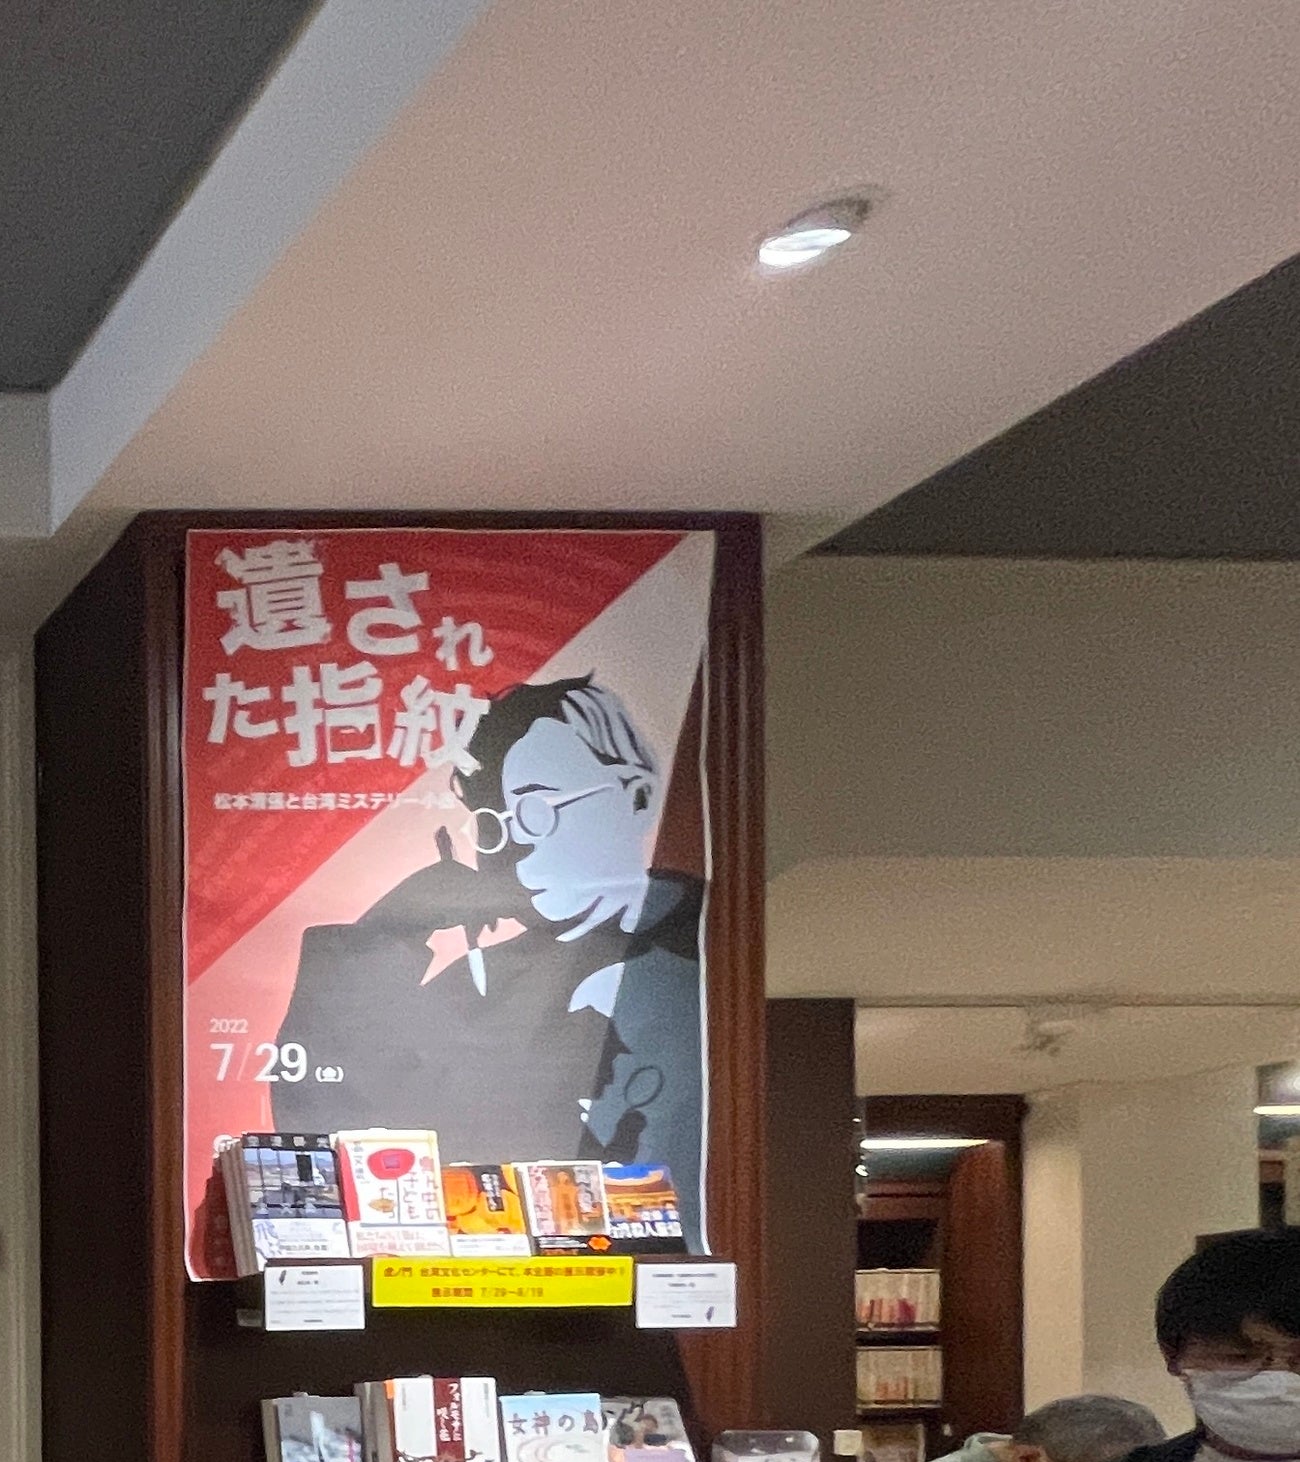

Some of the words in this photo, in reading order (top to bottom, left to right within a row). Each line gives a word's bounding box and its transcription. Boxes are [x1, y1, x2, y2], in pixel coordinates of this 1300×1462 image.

[213, 538, 494, 671] 遺され
[202, 660, 492, 776] た指紋
[209, 1018, 249, 1035] 2022
[210, 1042, 308, 1084] 7/29
[507, 1408, 600, 1437] 女神の島
